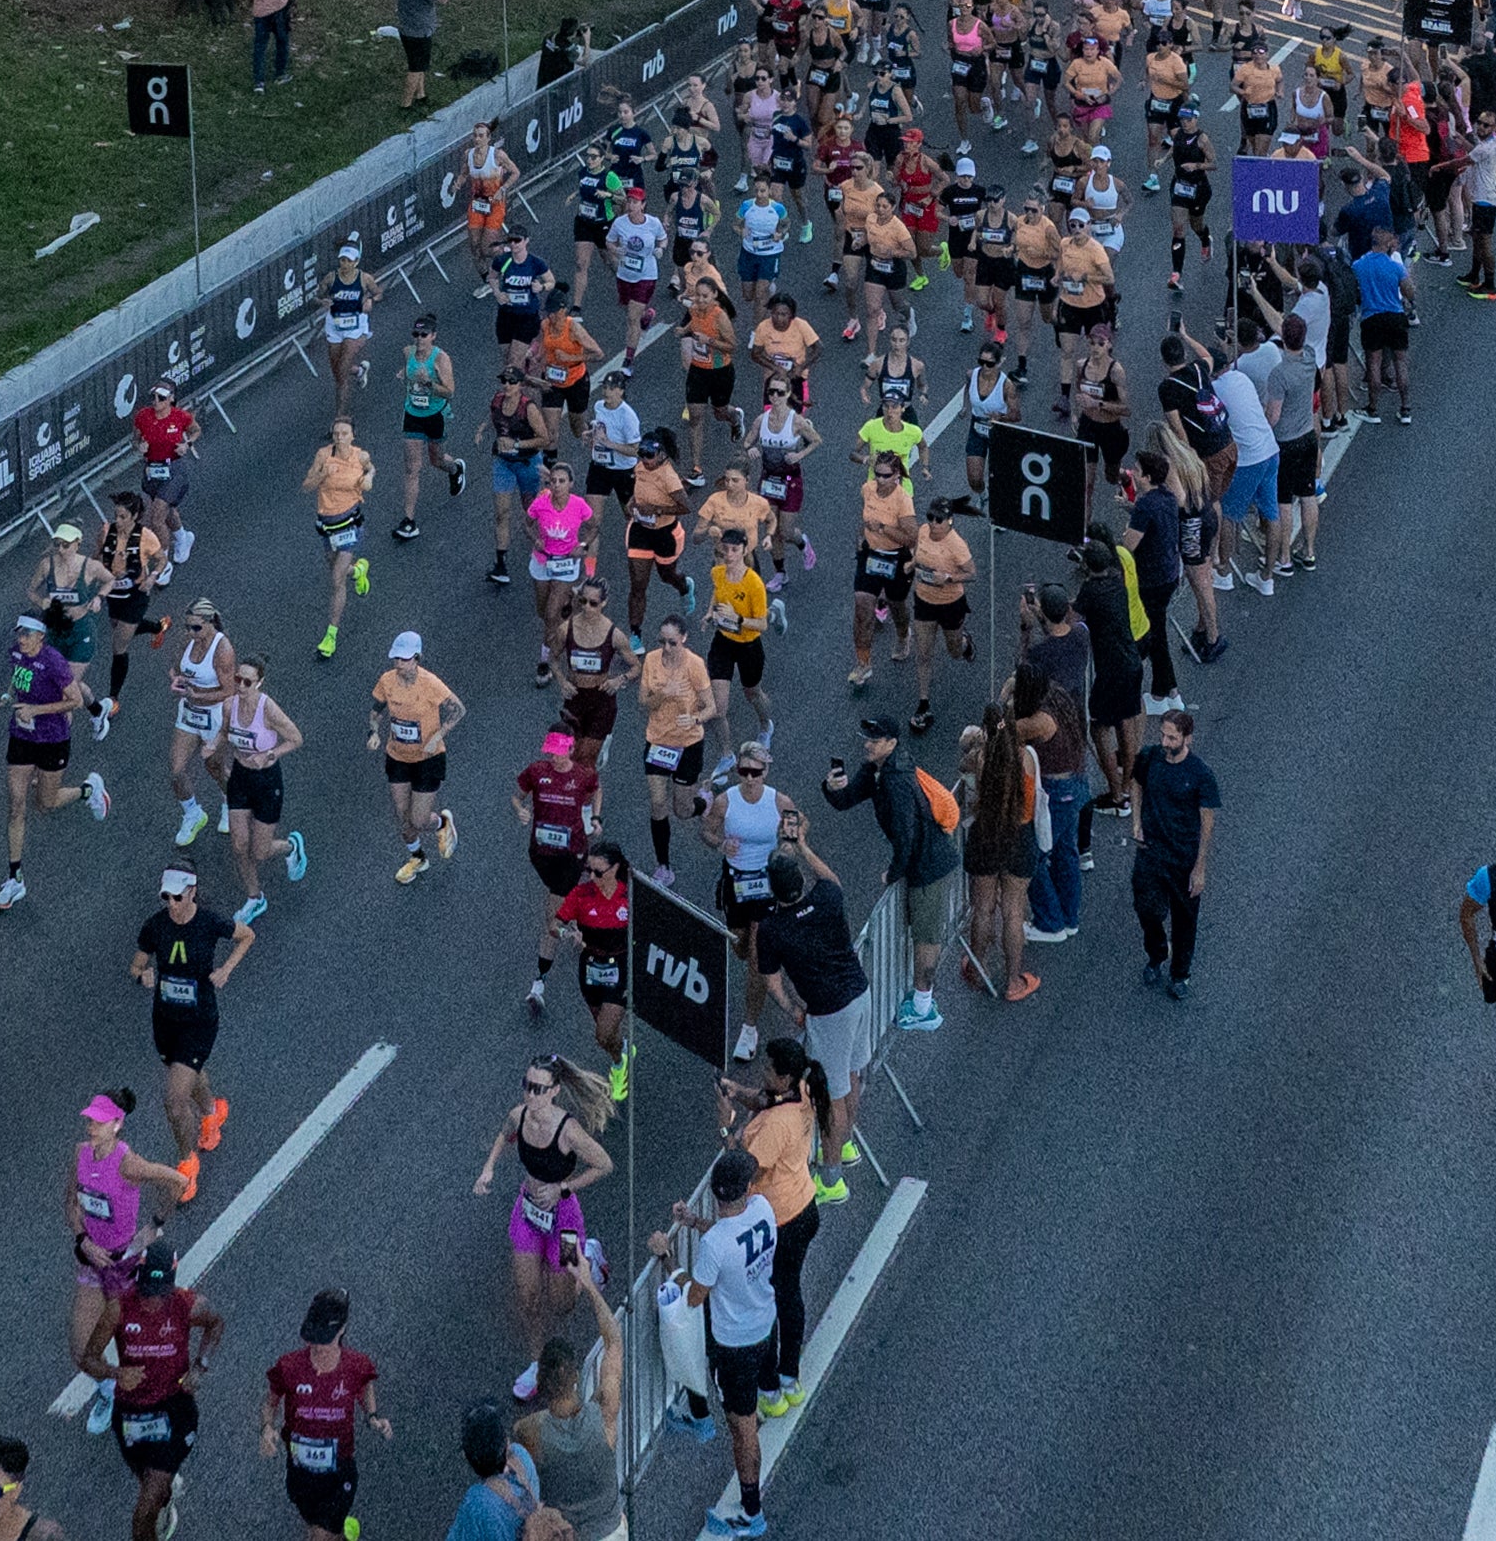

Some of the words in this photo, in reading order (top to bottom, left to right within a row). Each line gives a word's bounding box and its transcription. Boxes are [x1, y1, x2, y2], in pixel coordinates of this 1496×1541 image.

[717, 5, 739, 37] rvb
[642, 49, 666, 83] rvb
[558, 96, 584, 134] rvb
[1252, 187, 1300, 215] nu
[28, 441, 62, 469] IGUANA
[28, 453, 62, 480] SPORTS
[646, 943, 711, 1005] rvb
